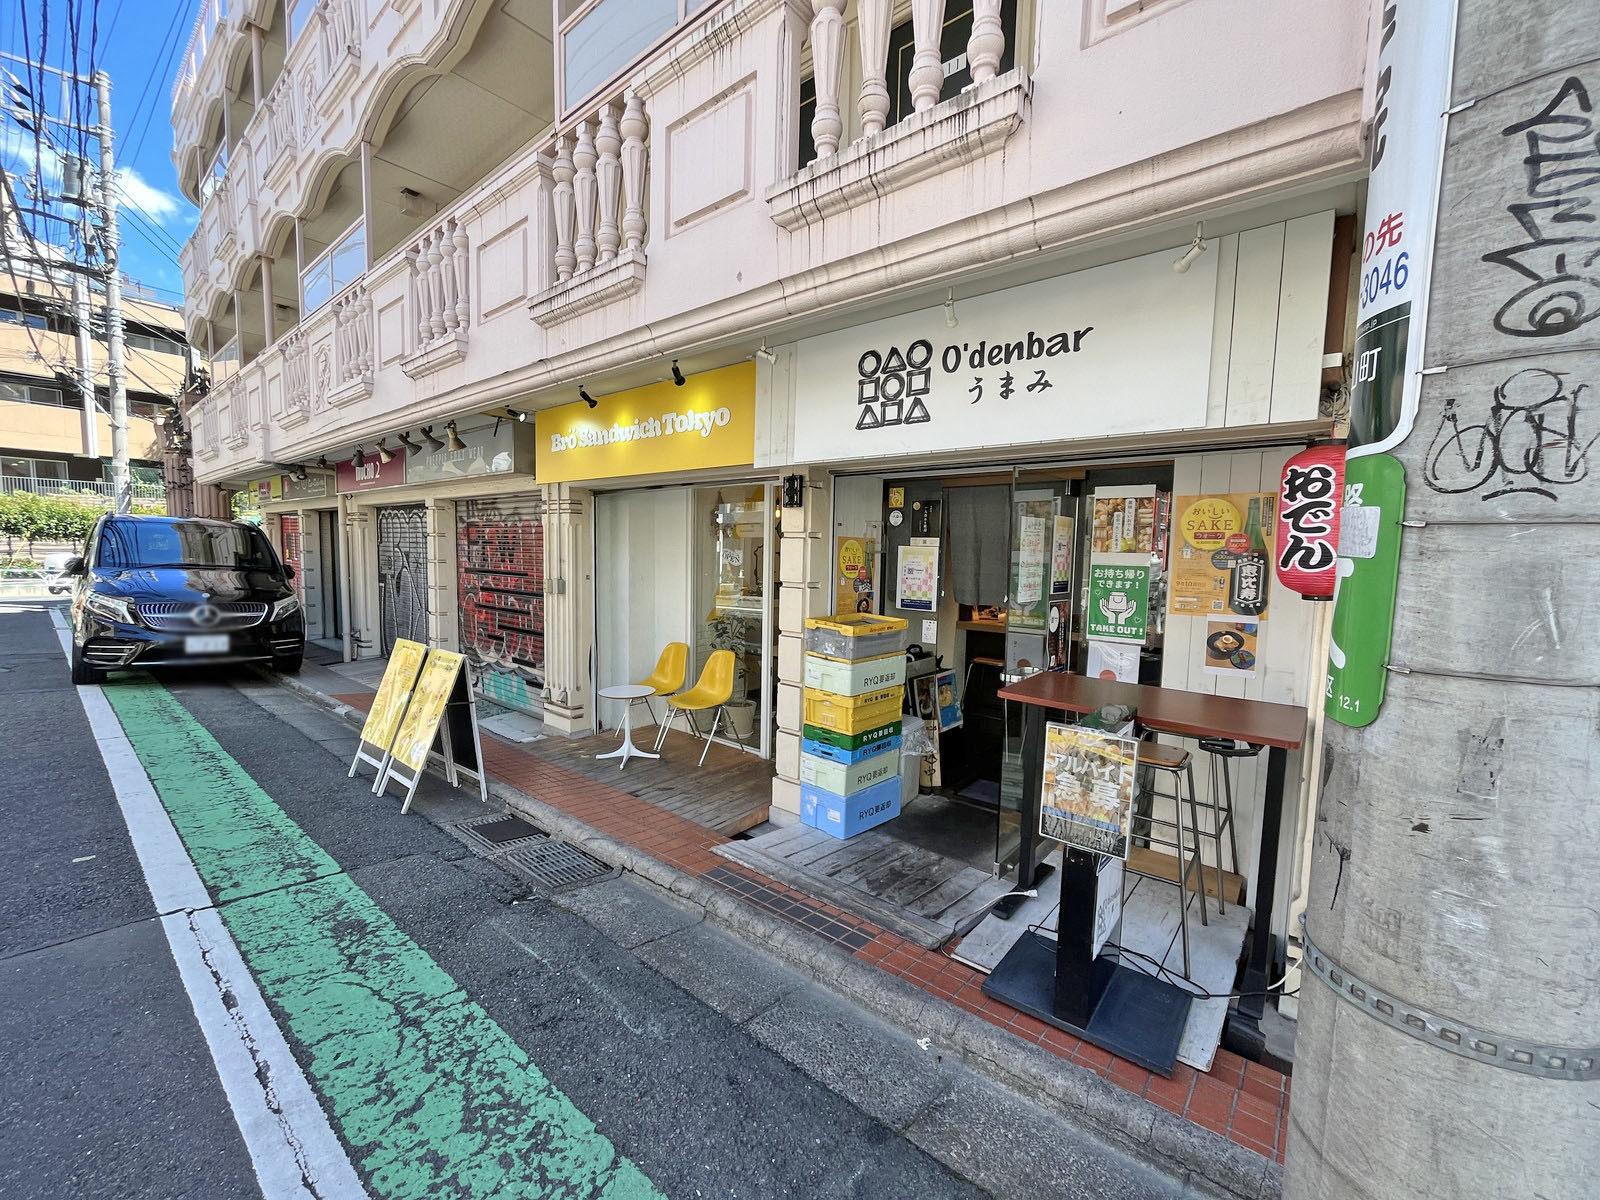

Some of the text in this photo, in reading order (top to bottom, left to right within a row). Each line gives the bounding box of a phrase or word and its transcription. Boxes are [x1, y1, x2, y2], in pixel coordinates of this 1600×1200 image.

[1362, 212, 1404, 264] の先
[942, 326, 1094, 373] O'denbar
[968, 369, 1053, 404] うまみ
[551, 406, 731, 452] Brö Sandwich Tokyo
[375, 461, 380, 478] 2
[1192, 507, 1230, 516] おいしい
[1279, 465, 1336, 571] おでん
[1186, 520, 1234, 531] SAKE
[722, 550, 740, 563] OPEN
[842, 556, 862, 564] SAKE
[1094, 568, 1145, 579] お持ち帰り
[1090, 623, 1116, 633] TAKE
[1338, 695, 1361, 713] 12.1
